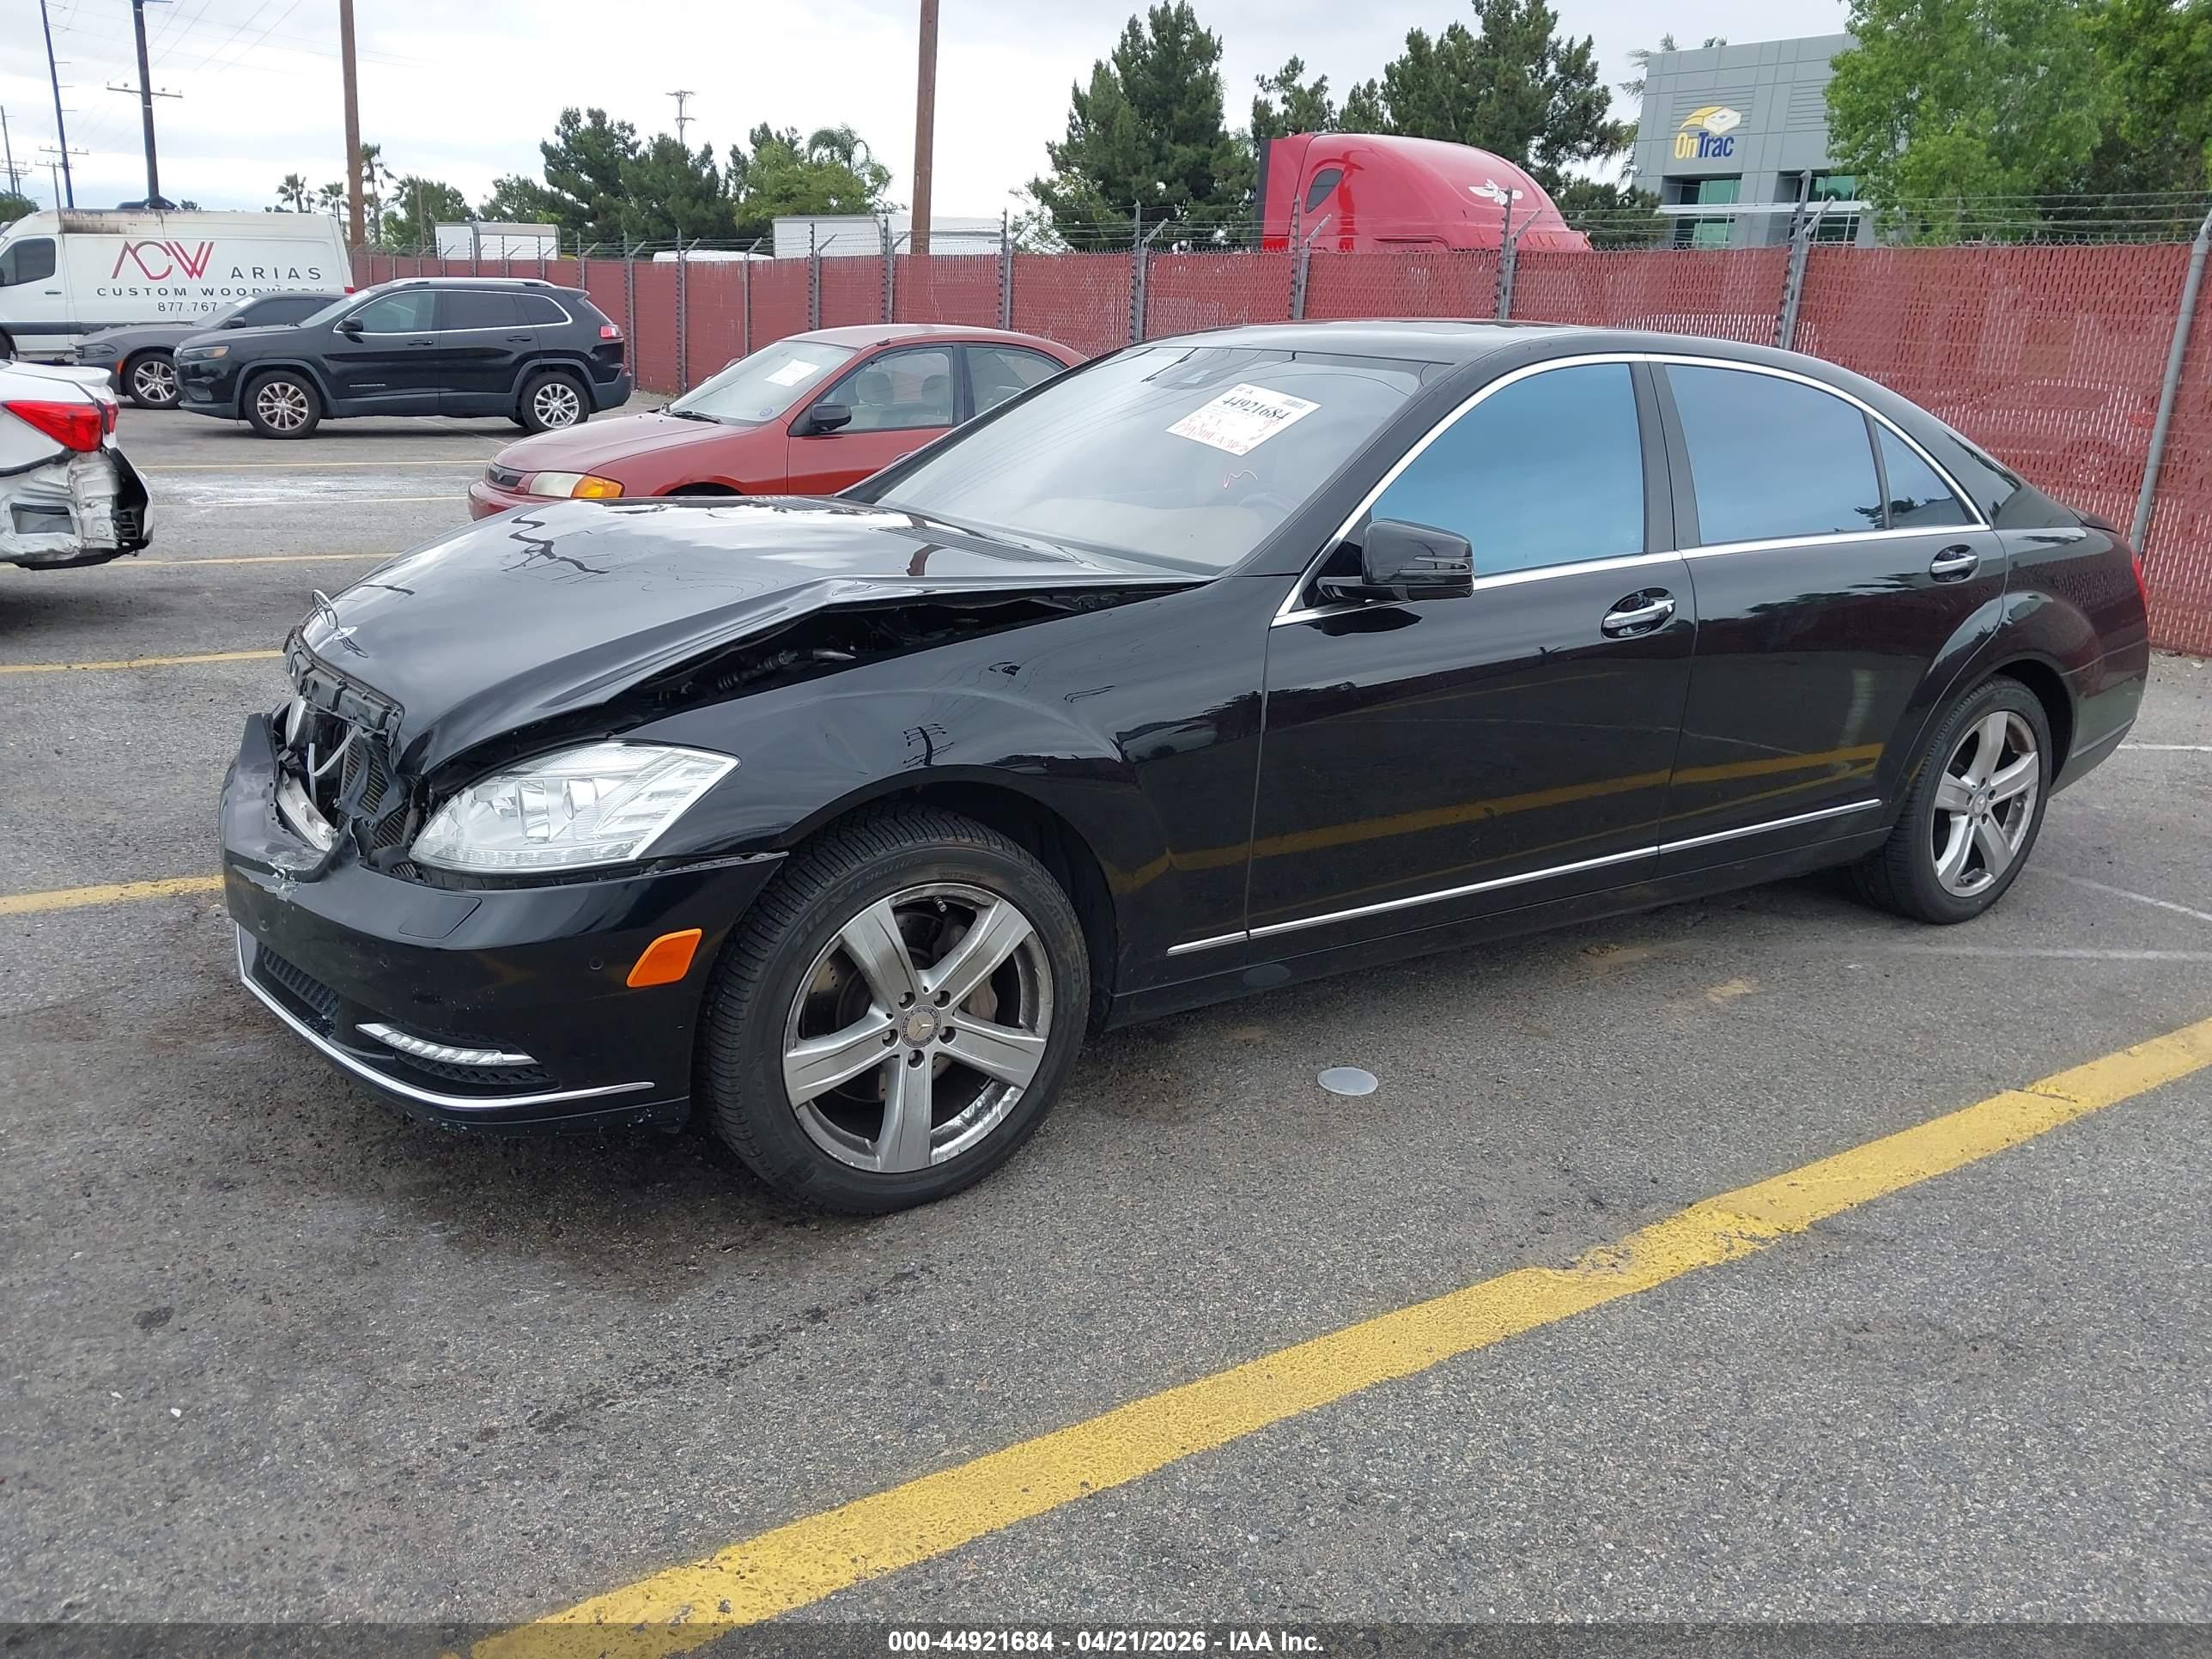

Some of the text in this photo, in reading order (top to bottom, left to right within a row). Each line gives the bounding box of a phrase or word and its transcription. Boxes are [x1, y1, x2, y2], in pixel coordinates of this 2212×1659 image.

[1675, 131, 1735, 159] OnTrac
[230, 266, 322, 281] ARIAS
[96, 287, 187, 297] CUSTOM
[1222, 396, 1292, 421] 44921684
